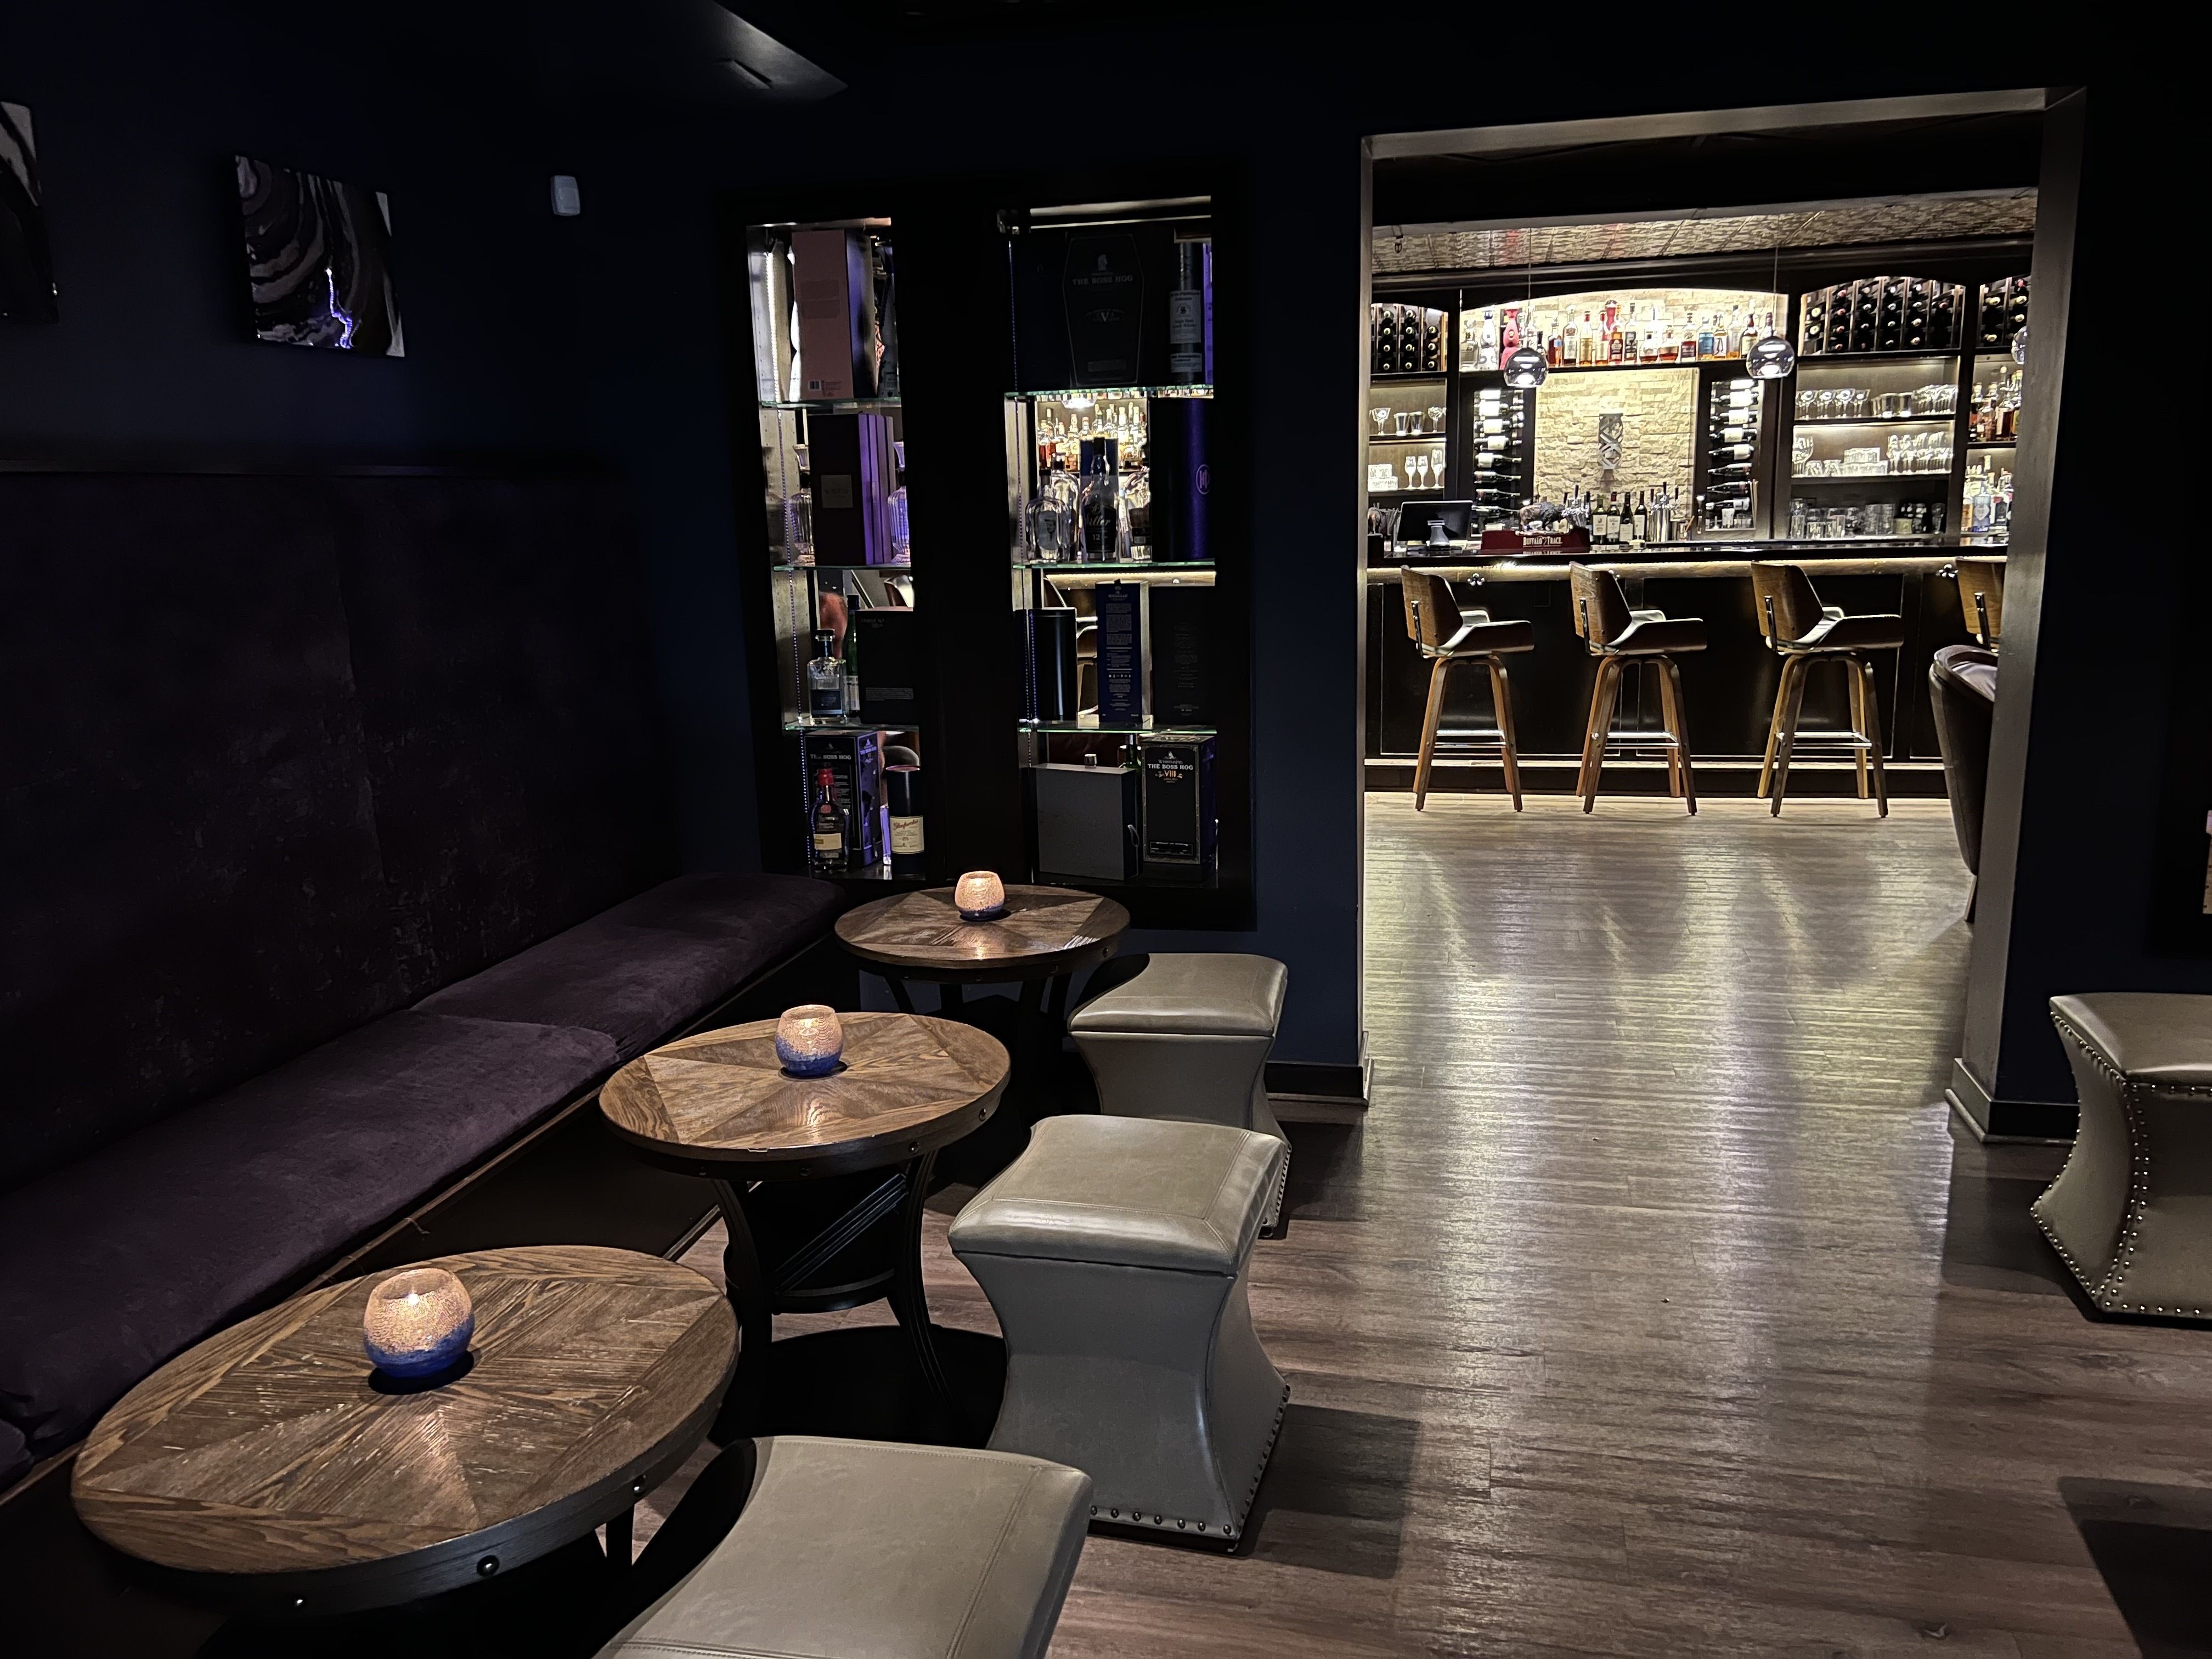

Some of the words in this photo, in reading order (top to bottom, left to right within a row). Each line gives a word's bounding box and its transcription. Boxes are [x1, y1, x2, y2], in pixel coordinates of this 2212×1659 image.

[1115, 274, 1133, 283] HOG
[1523, 536, 1543, 546] BUFFALO
[1547, 536, 1563, 545] TRACE
[1164, 770, 1176, 778] VIII
